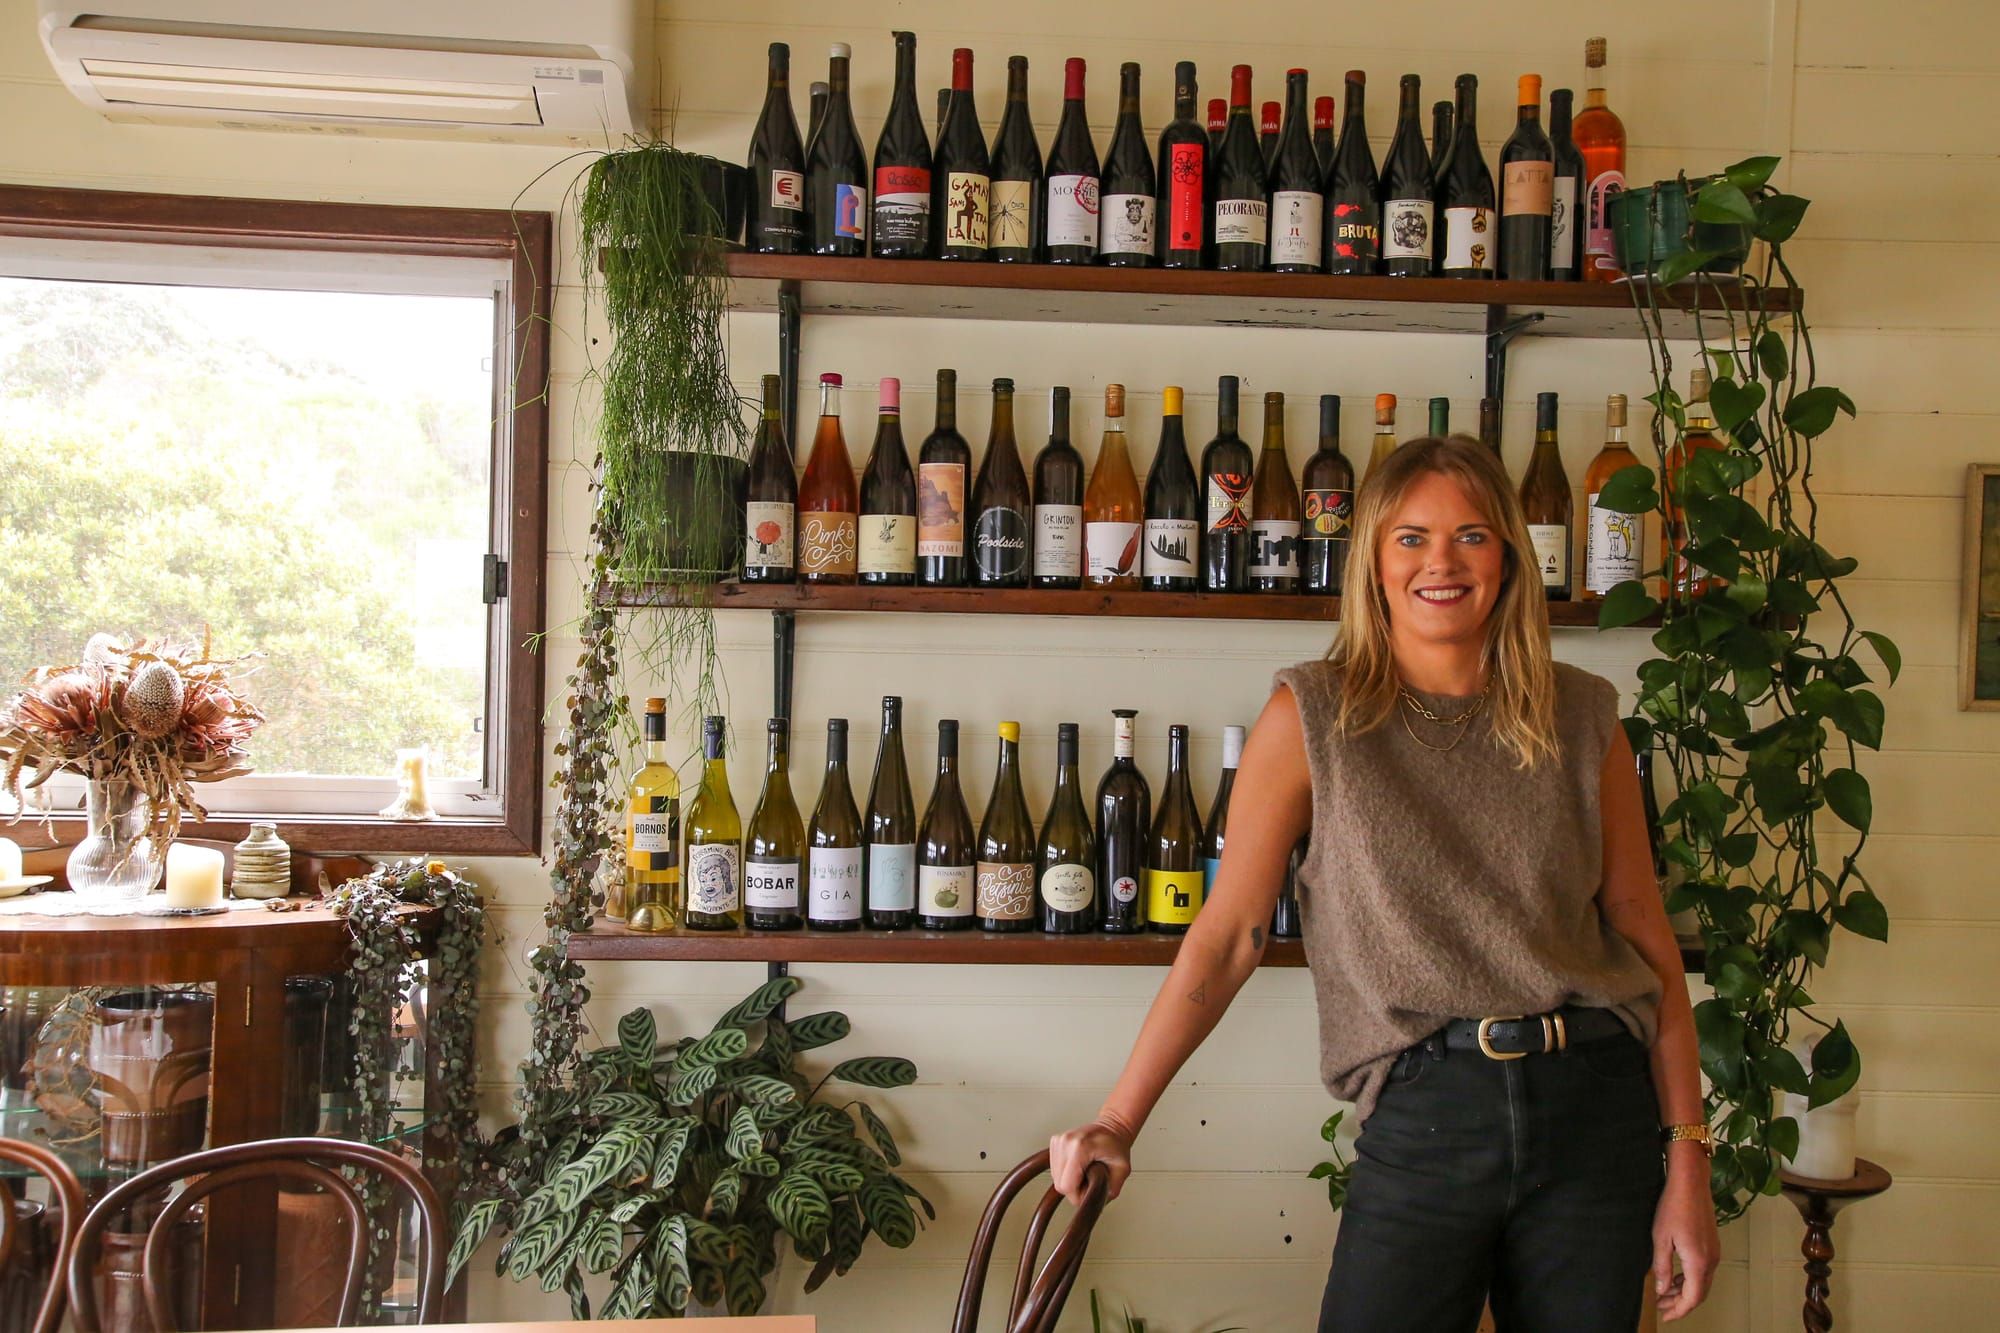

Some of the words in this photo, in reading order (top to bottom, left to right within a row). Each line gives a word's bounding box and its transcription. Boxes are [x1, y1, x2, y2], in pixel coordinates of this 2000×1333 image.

[977, 533, 1025, 549] Poolside
[635, 823, 667, 834] BORNOS
[747, 876, 795, 890] BOBAR
